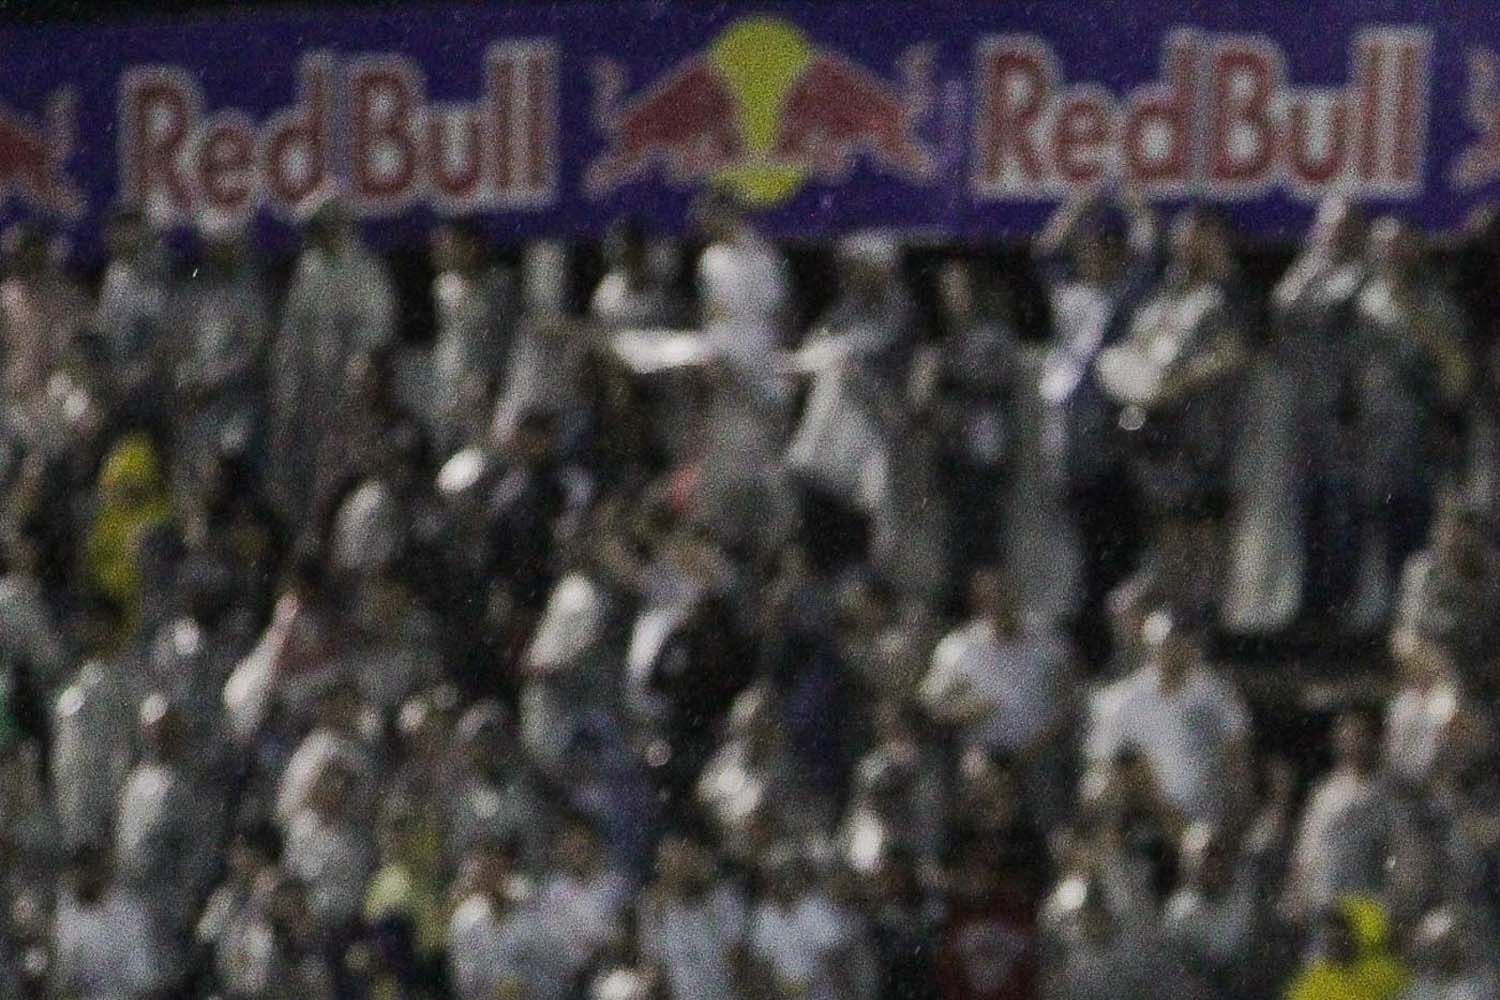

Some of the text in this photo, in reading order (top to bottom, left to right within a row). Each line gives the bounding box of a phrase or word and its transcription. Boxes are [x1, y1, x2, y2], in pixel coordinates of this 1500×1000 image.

[120, 40, 560, 226] Red Bull
[974, 26, 1432, 196] Red Bull
